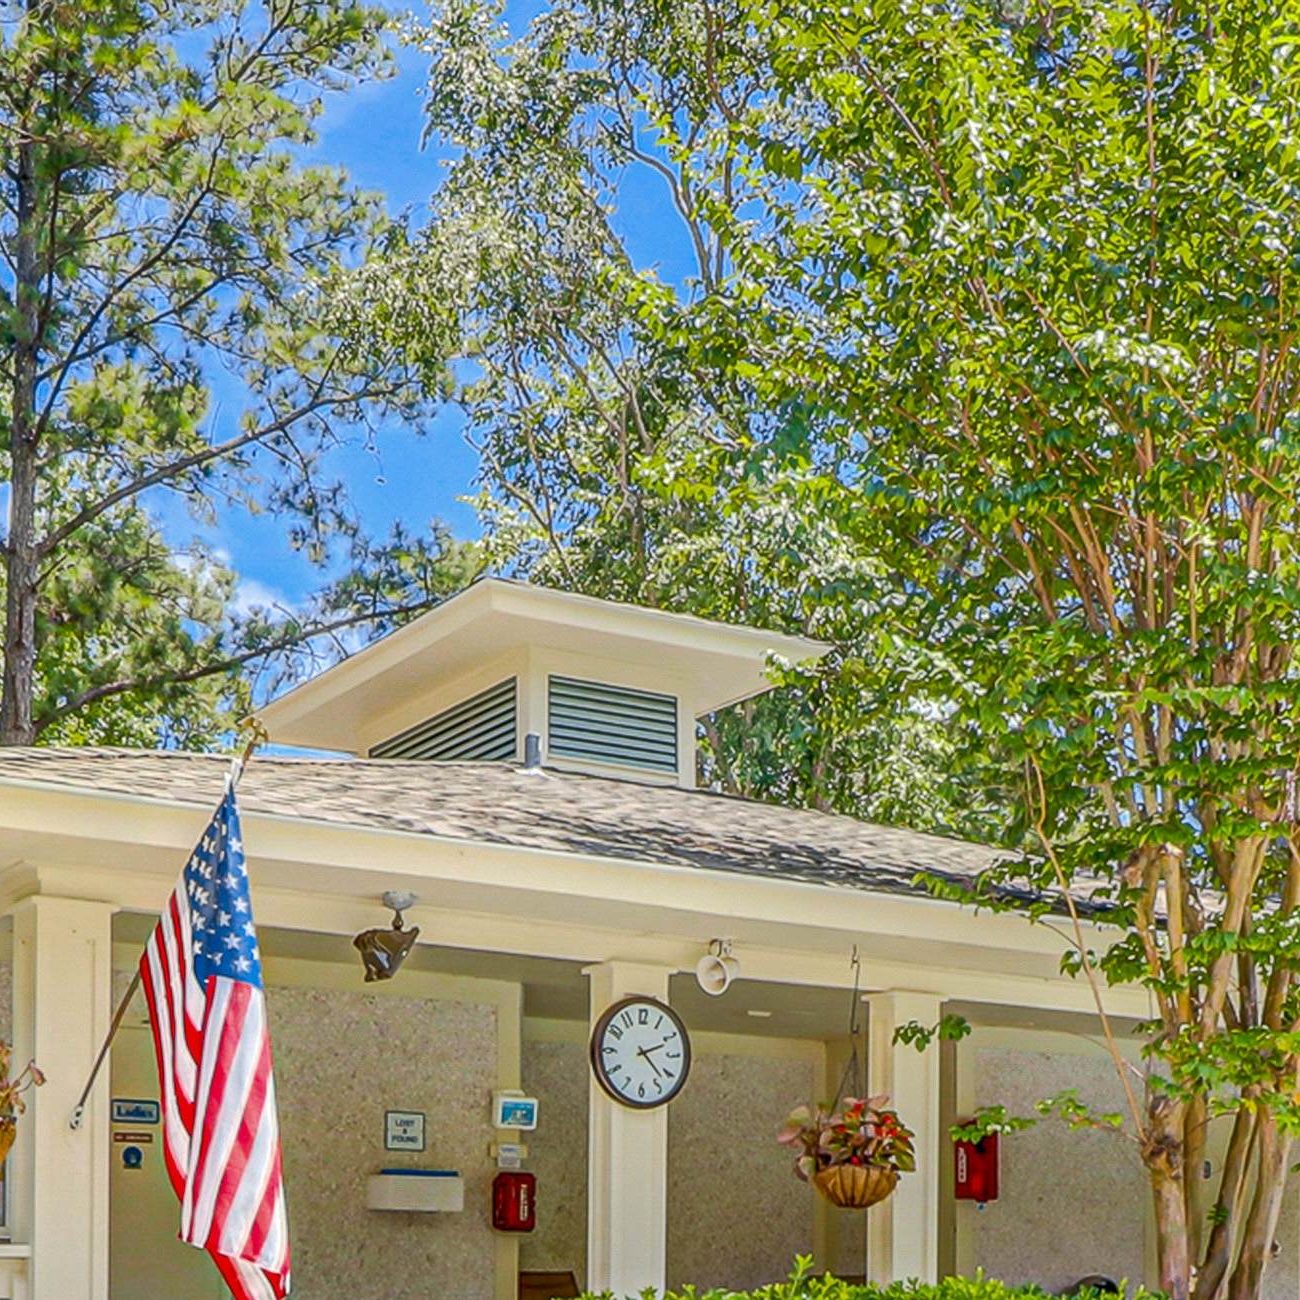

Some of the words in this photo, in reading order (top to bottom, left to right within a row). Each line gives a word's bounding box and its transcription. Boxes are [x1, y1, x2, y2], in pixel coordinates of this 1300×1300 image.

[620, 1011, 634, 1029] 11
[638, 1008, 649, 1025] 12
[654, 1015, 663, 1029] 1
[663, 1032, 677, 1042] 2
[602, 1046, 618, 1054] 9
[662, 1068, 675, 1079] 4
[621, 1076, 632, 1090] 7
[638, 1082, 645, 1098] 6
[653, 1078, 662, 1095] 5
